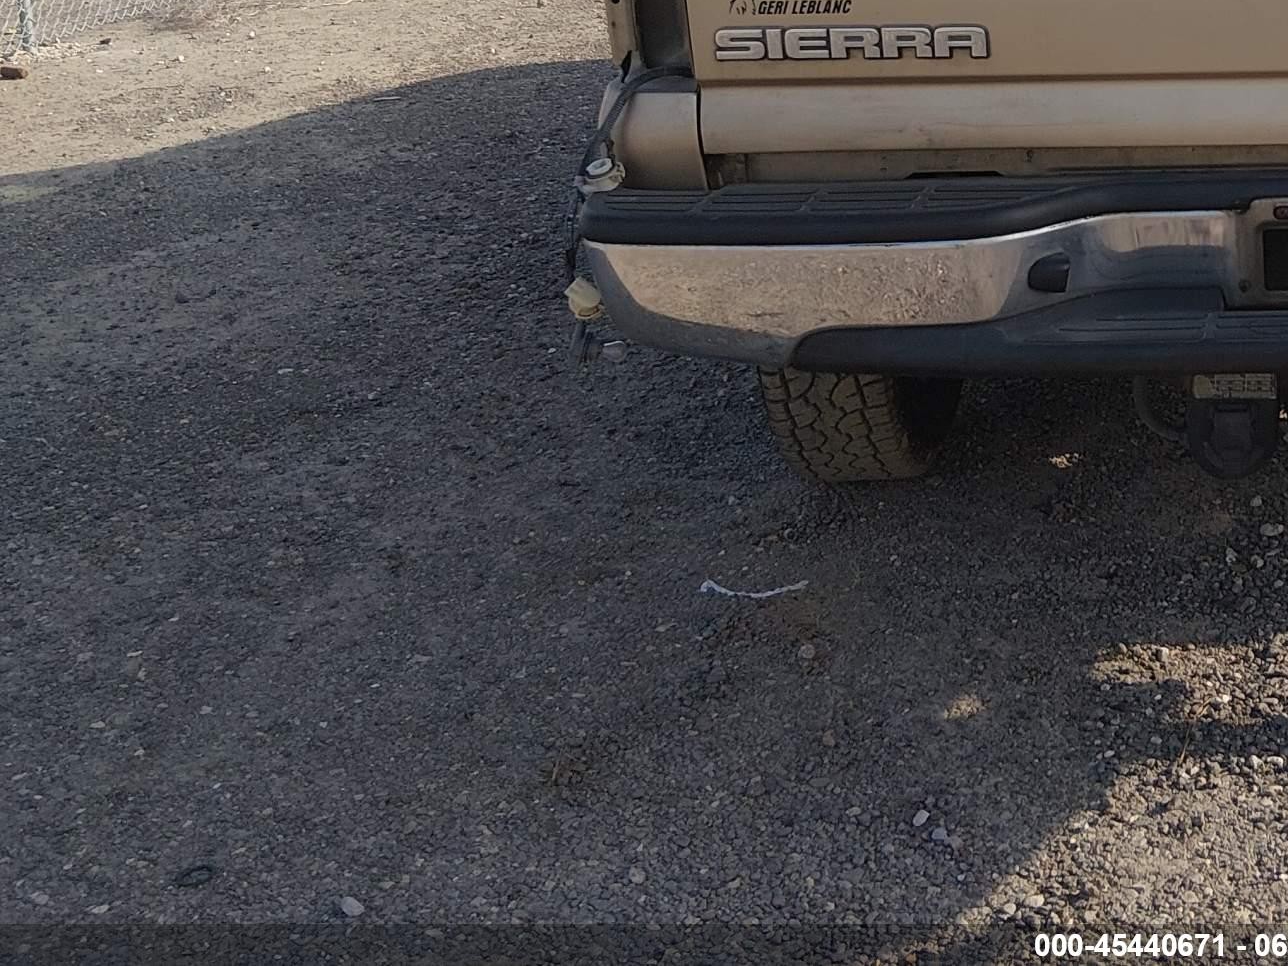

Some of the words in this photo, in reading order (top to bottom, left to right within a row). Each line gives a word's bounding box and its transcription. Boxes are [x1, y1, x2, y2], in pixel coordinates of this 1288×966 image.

[758, 0, 789, 15] GERI
[792, 0, 852, 15] LEBLANC
[713, 24, 990, 61] SIERRA
